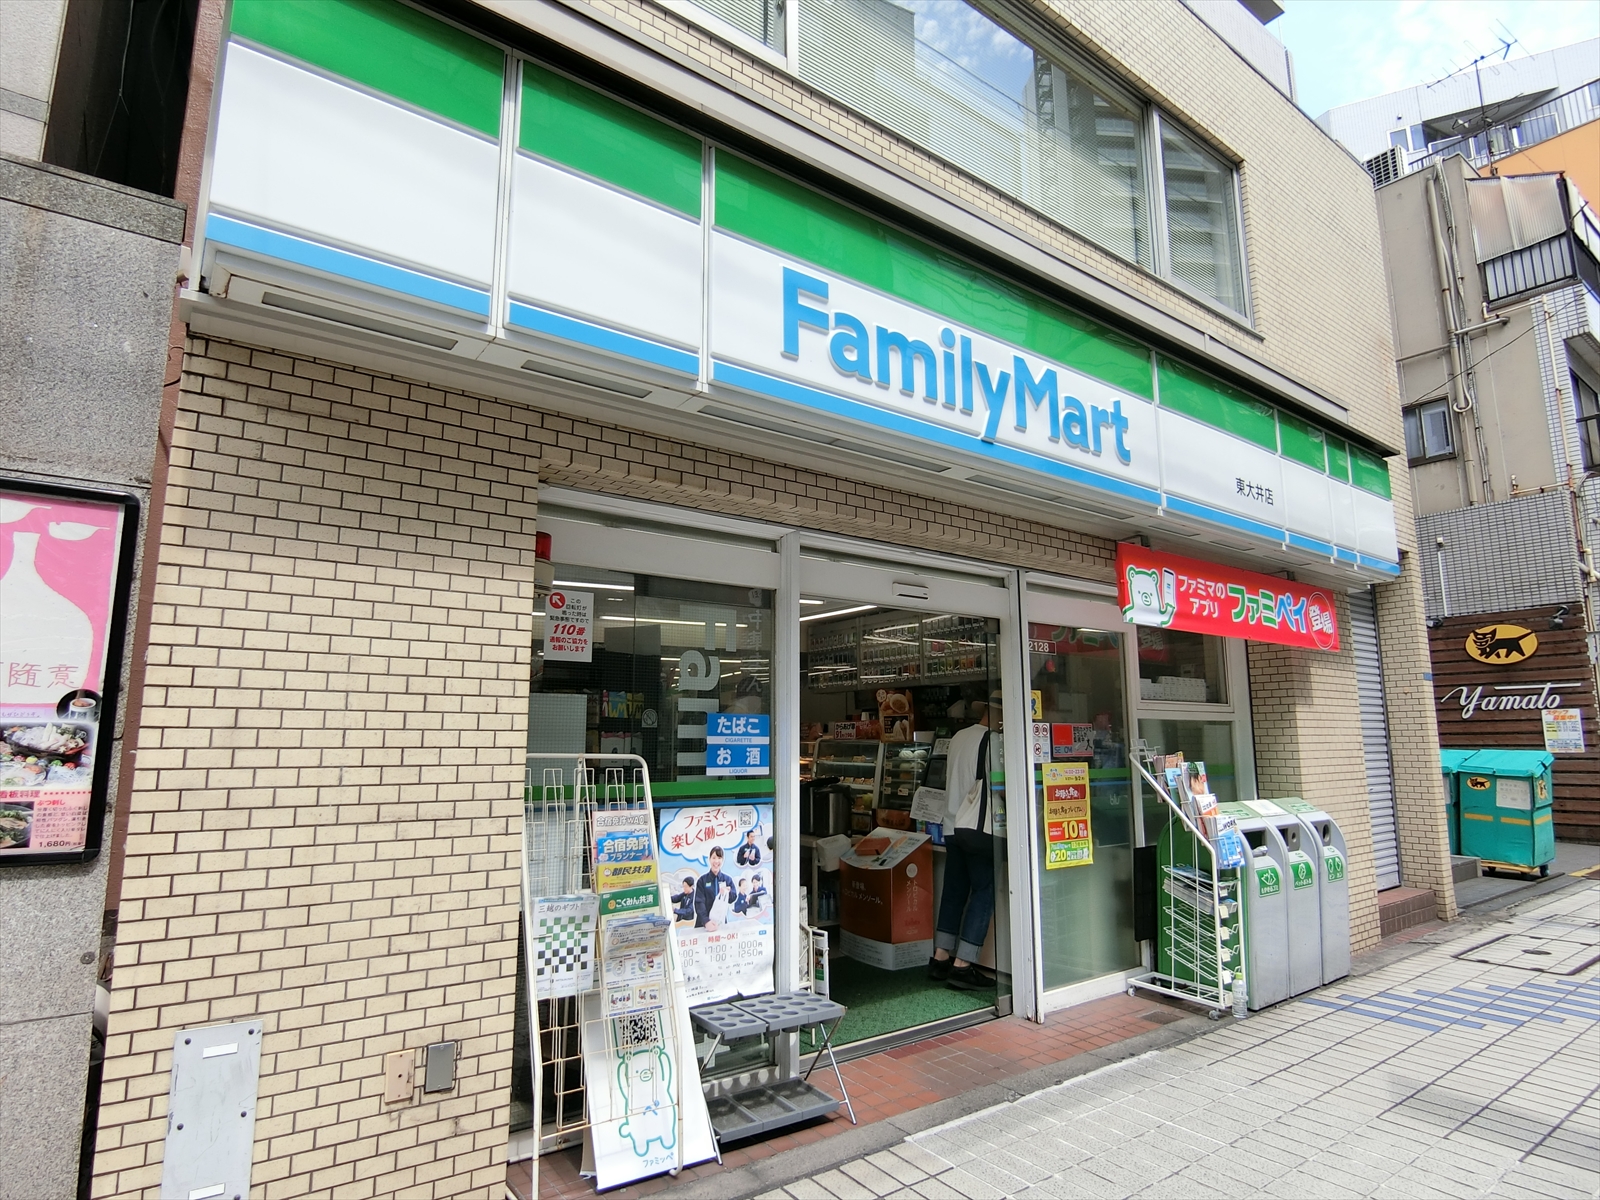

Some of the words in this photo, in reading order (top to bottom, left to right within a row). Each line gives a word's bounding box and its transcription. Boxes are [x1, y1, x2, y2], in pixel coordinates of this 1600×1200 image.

[781, 265, 1132, 466] FamilyMart
[1236, 477, 1274, 506] 東大井店
[1177, 575, 1226, 599] ファミマの
[1189, 597, 1219, 618] アプリ
[1227, 584, 1307, 634] ファミペイ
[553, 623, 586, 636] 110番
[549, 635, 588, 646] 通報のご協力を
[552, 644, 586, 652] お願いします
[1028, 640, 1049, 652] 2128
[1441, 683, 1582, 720] Yamato
[717, 716, 760, 734] たばこ
[684, 808, 728, 829] ファミマで
[671, 820, 738, 851] 楽しく働こう!
[1062, 820, 1079, 839] 10
[603, 836, 649, 854] 合宿免許
[610, 852, 643, 861] プランナー
